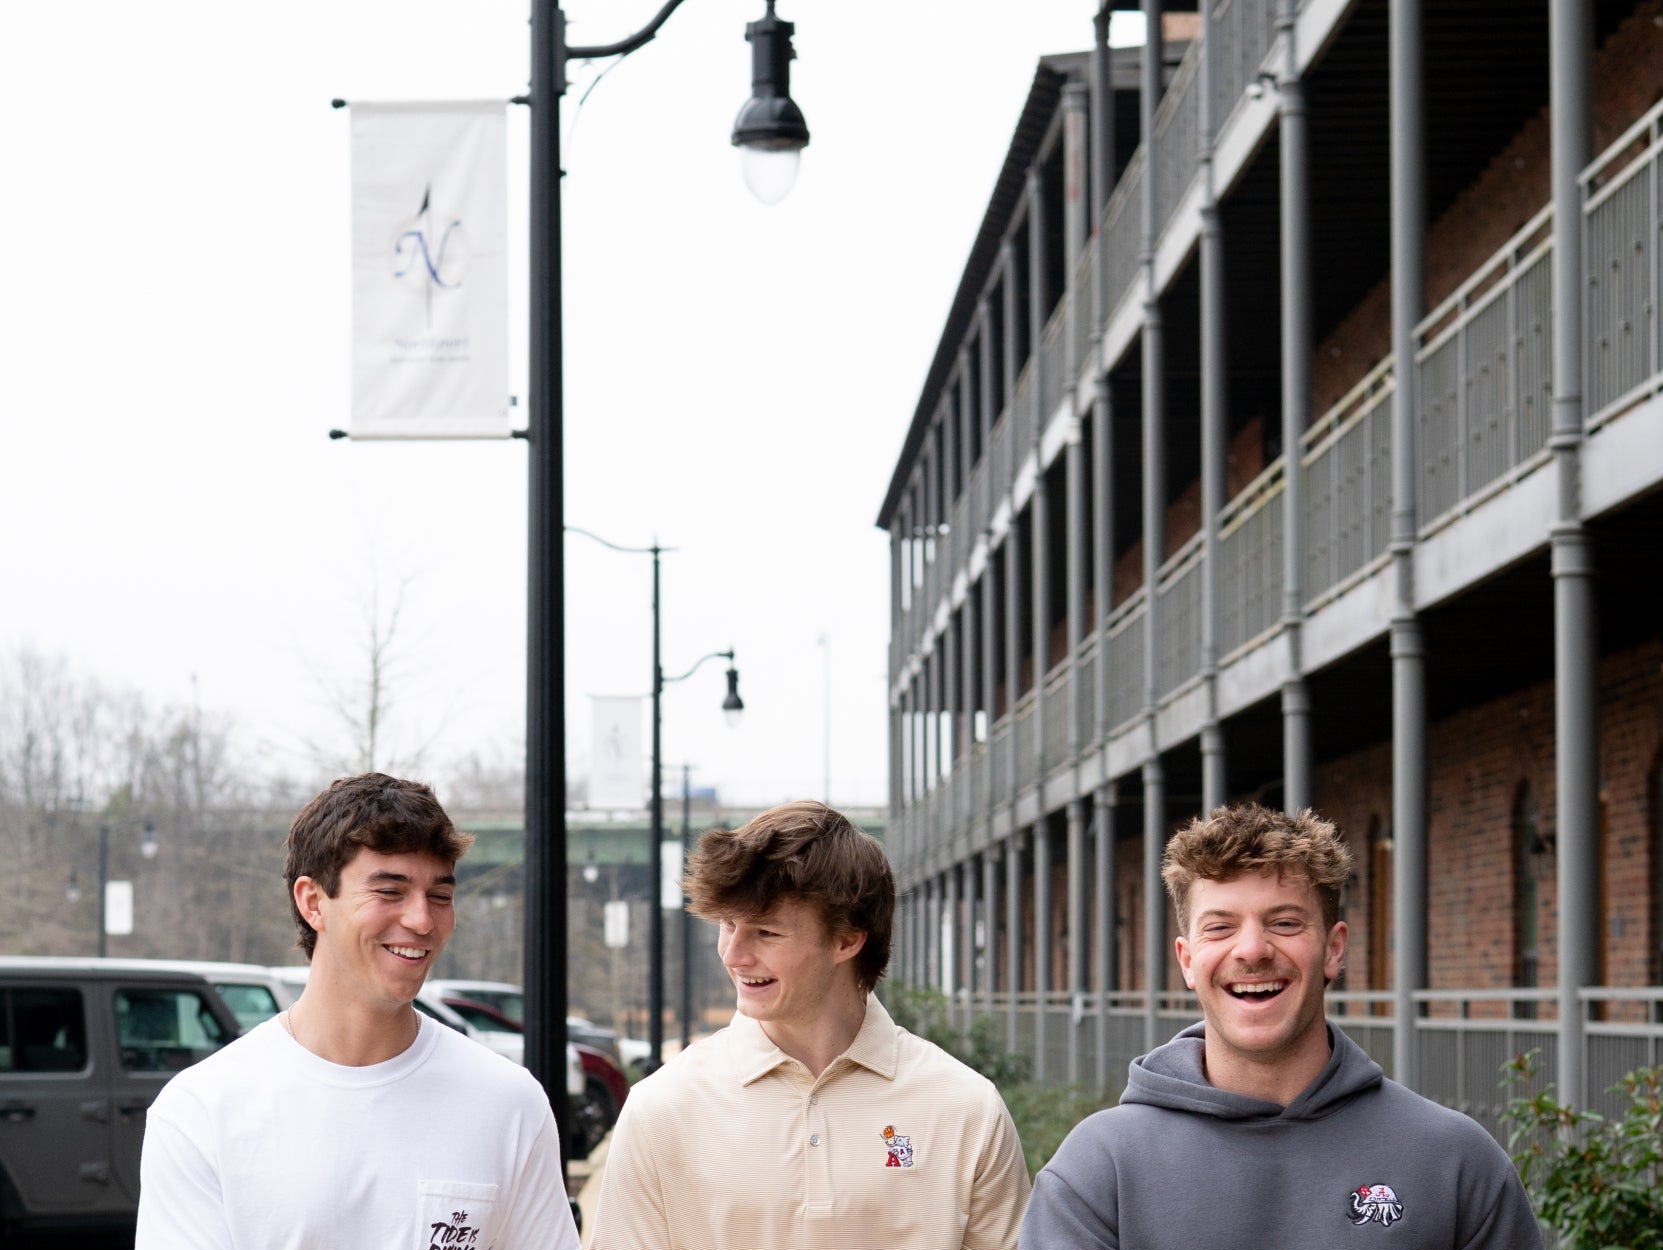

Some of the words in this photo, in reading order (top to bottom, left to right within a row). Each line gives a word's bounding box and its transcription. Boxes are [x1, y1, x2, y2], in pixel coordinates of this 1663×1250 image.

[452, 1210, 468, 1225] THE
[431, 1222, 471, 1243] TIDE
[469, 1229, 480, 1243] IS
